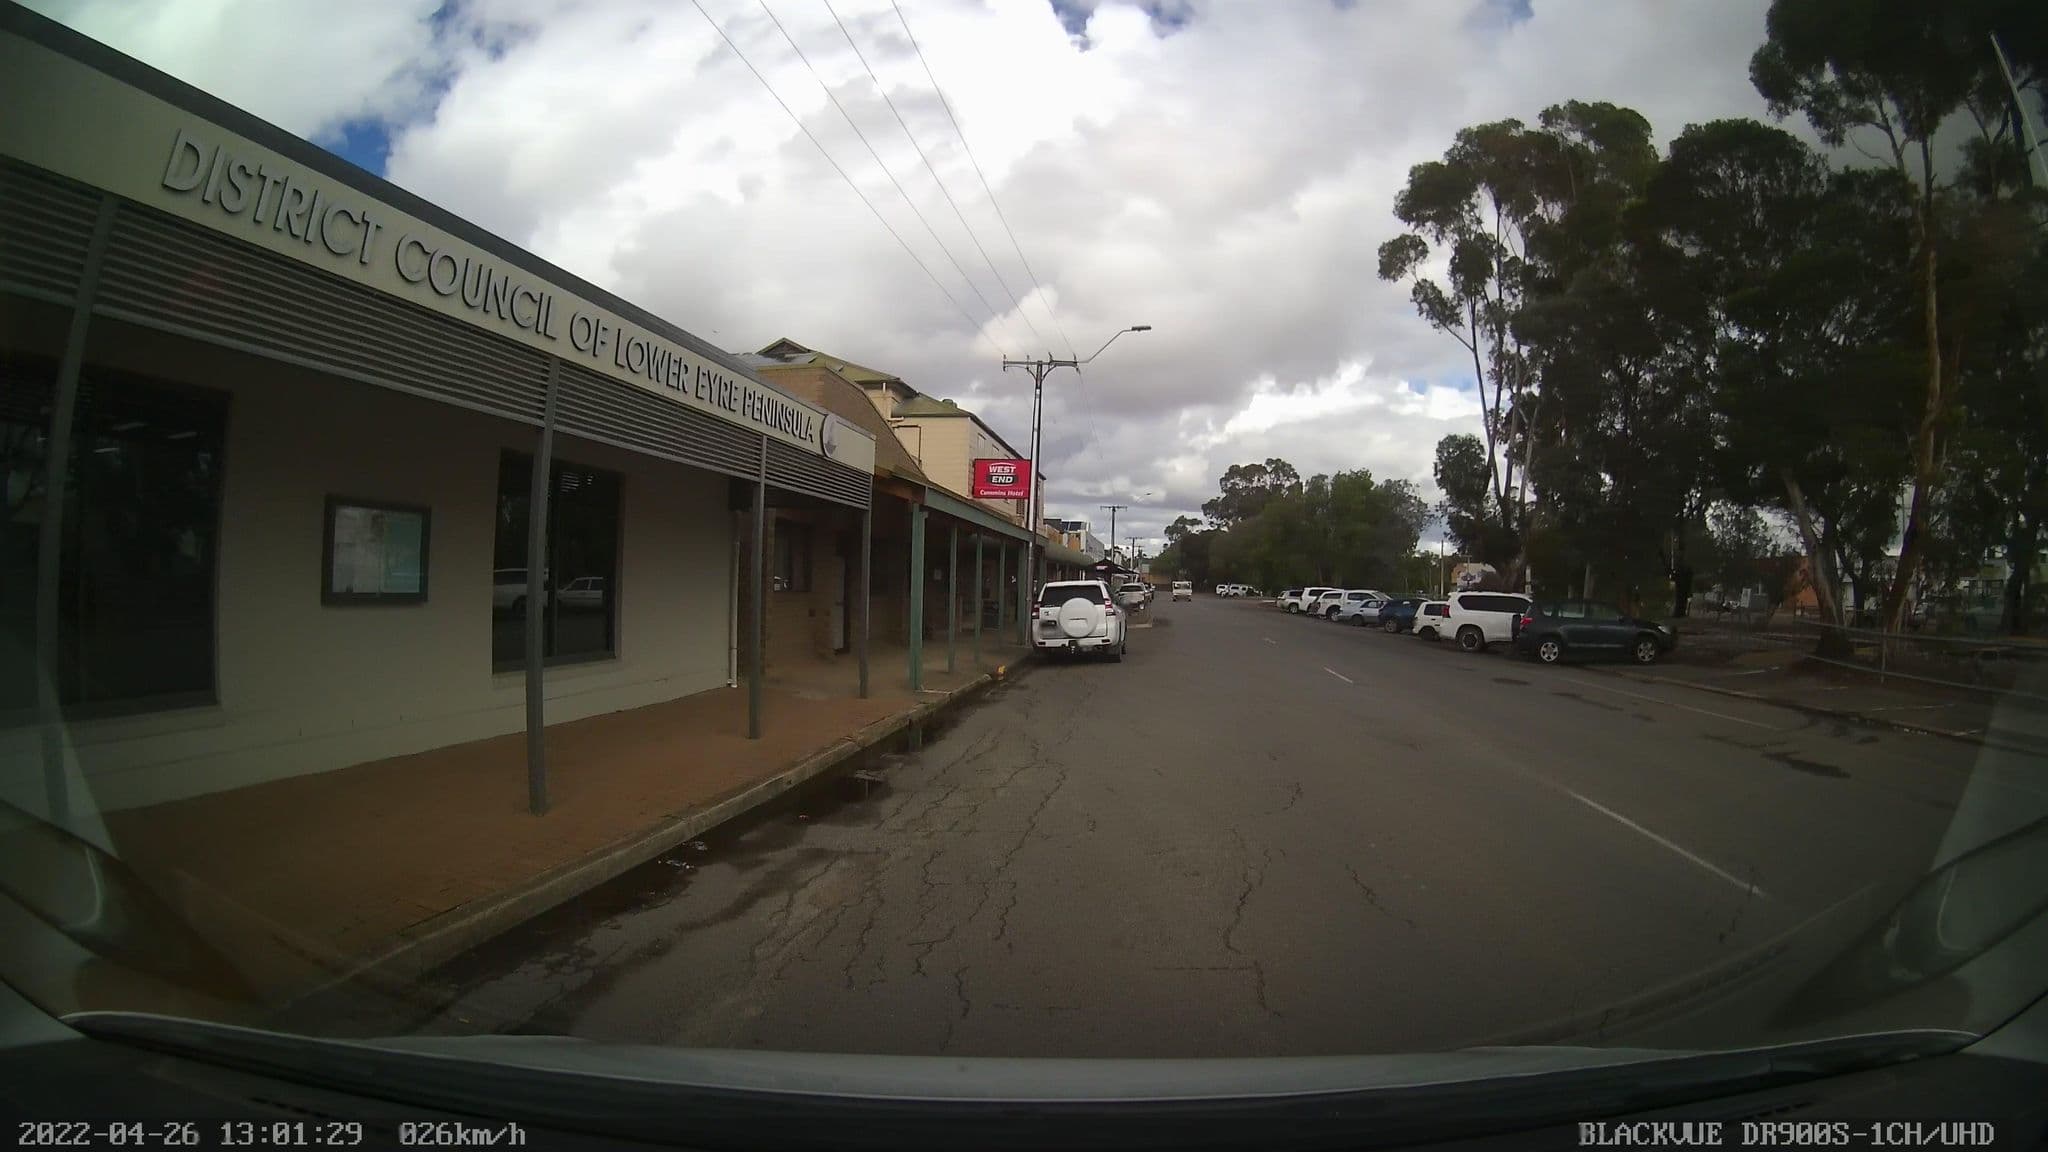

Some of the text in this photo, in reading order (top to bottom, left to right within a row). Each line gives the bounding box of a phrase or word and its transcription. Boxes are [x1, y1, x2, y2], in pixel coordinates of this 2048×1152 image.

[162, 128, 814, 443] DISTRICT COUNCIL OF LOWER EYRE PENINSULA
[991, 475, 1013, 483] END
